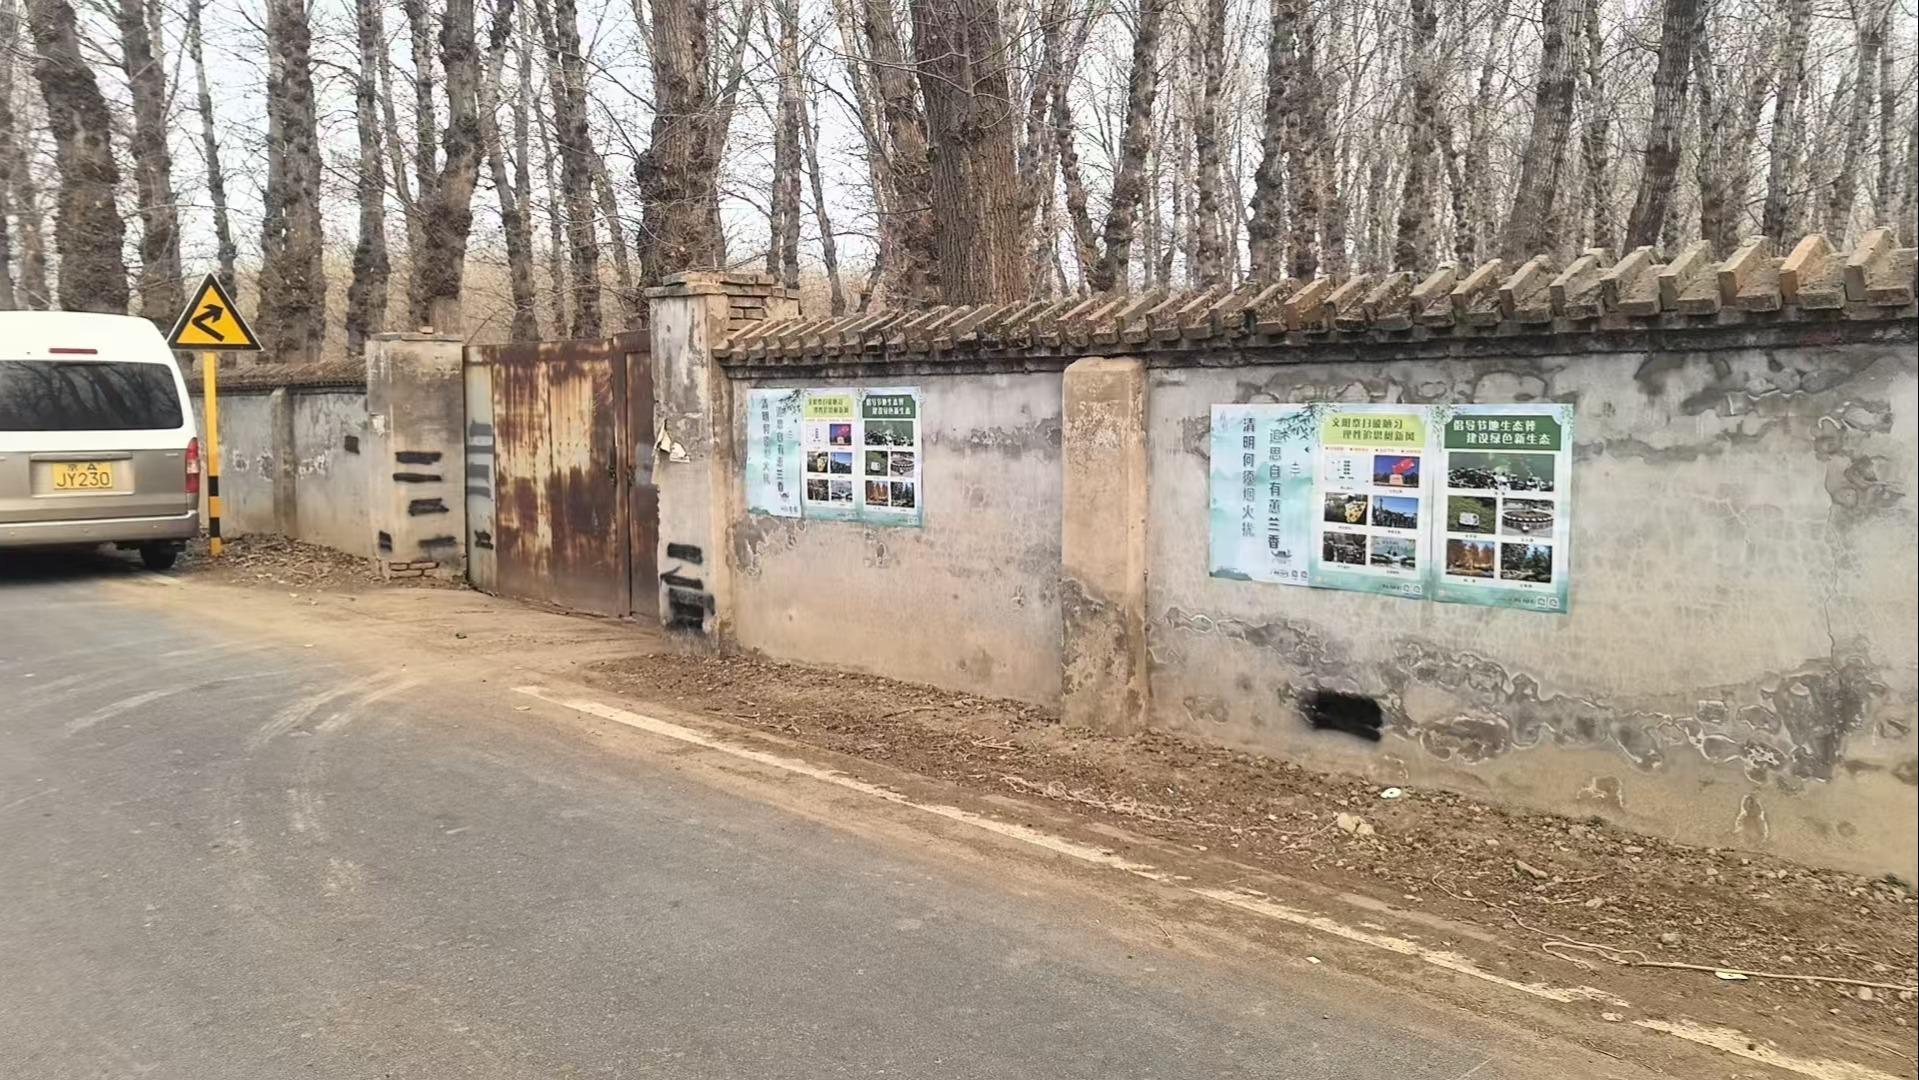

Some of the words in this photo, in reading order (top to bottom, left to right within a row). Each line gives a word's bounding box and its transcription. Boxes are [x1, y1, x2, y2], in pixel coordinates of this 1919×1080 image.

[1466, 432, 1551, 445] 建设绿色新生态
[56, 471, 111, 487] JY230
